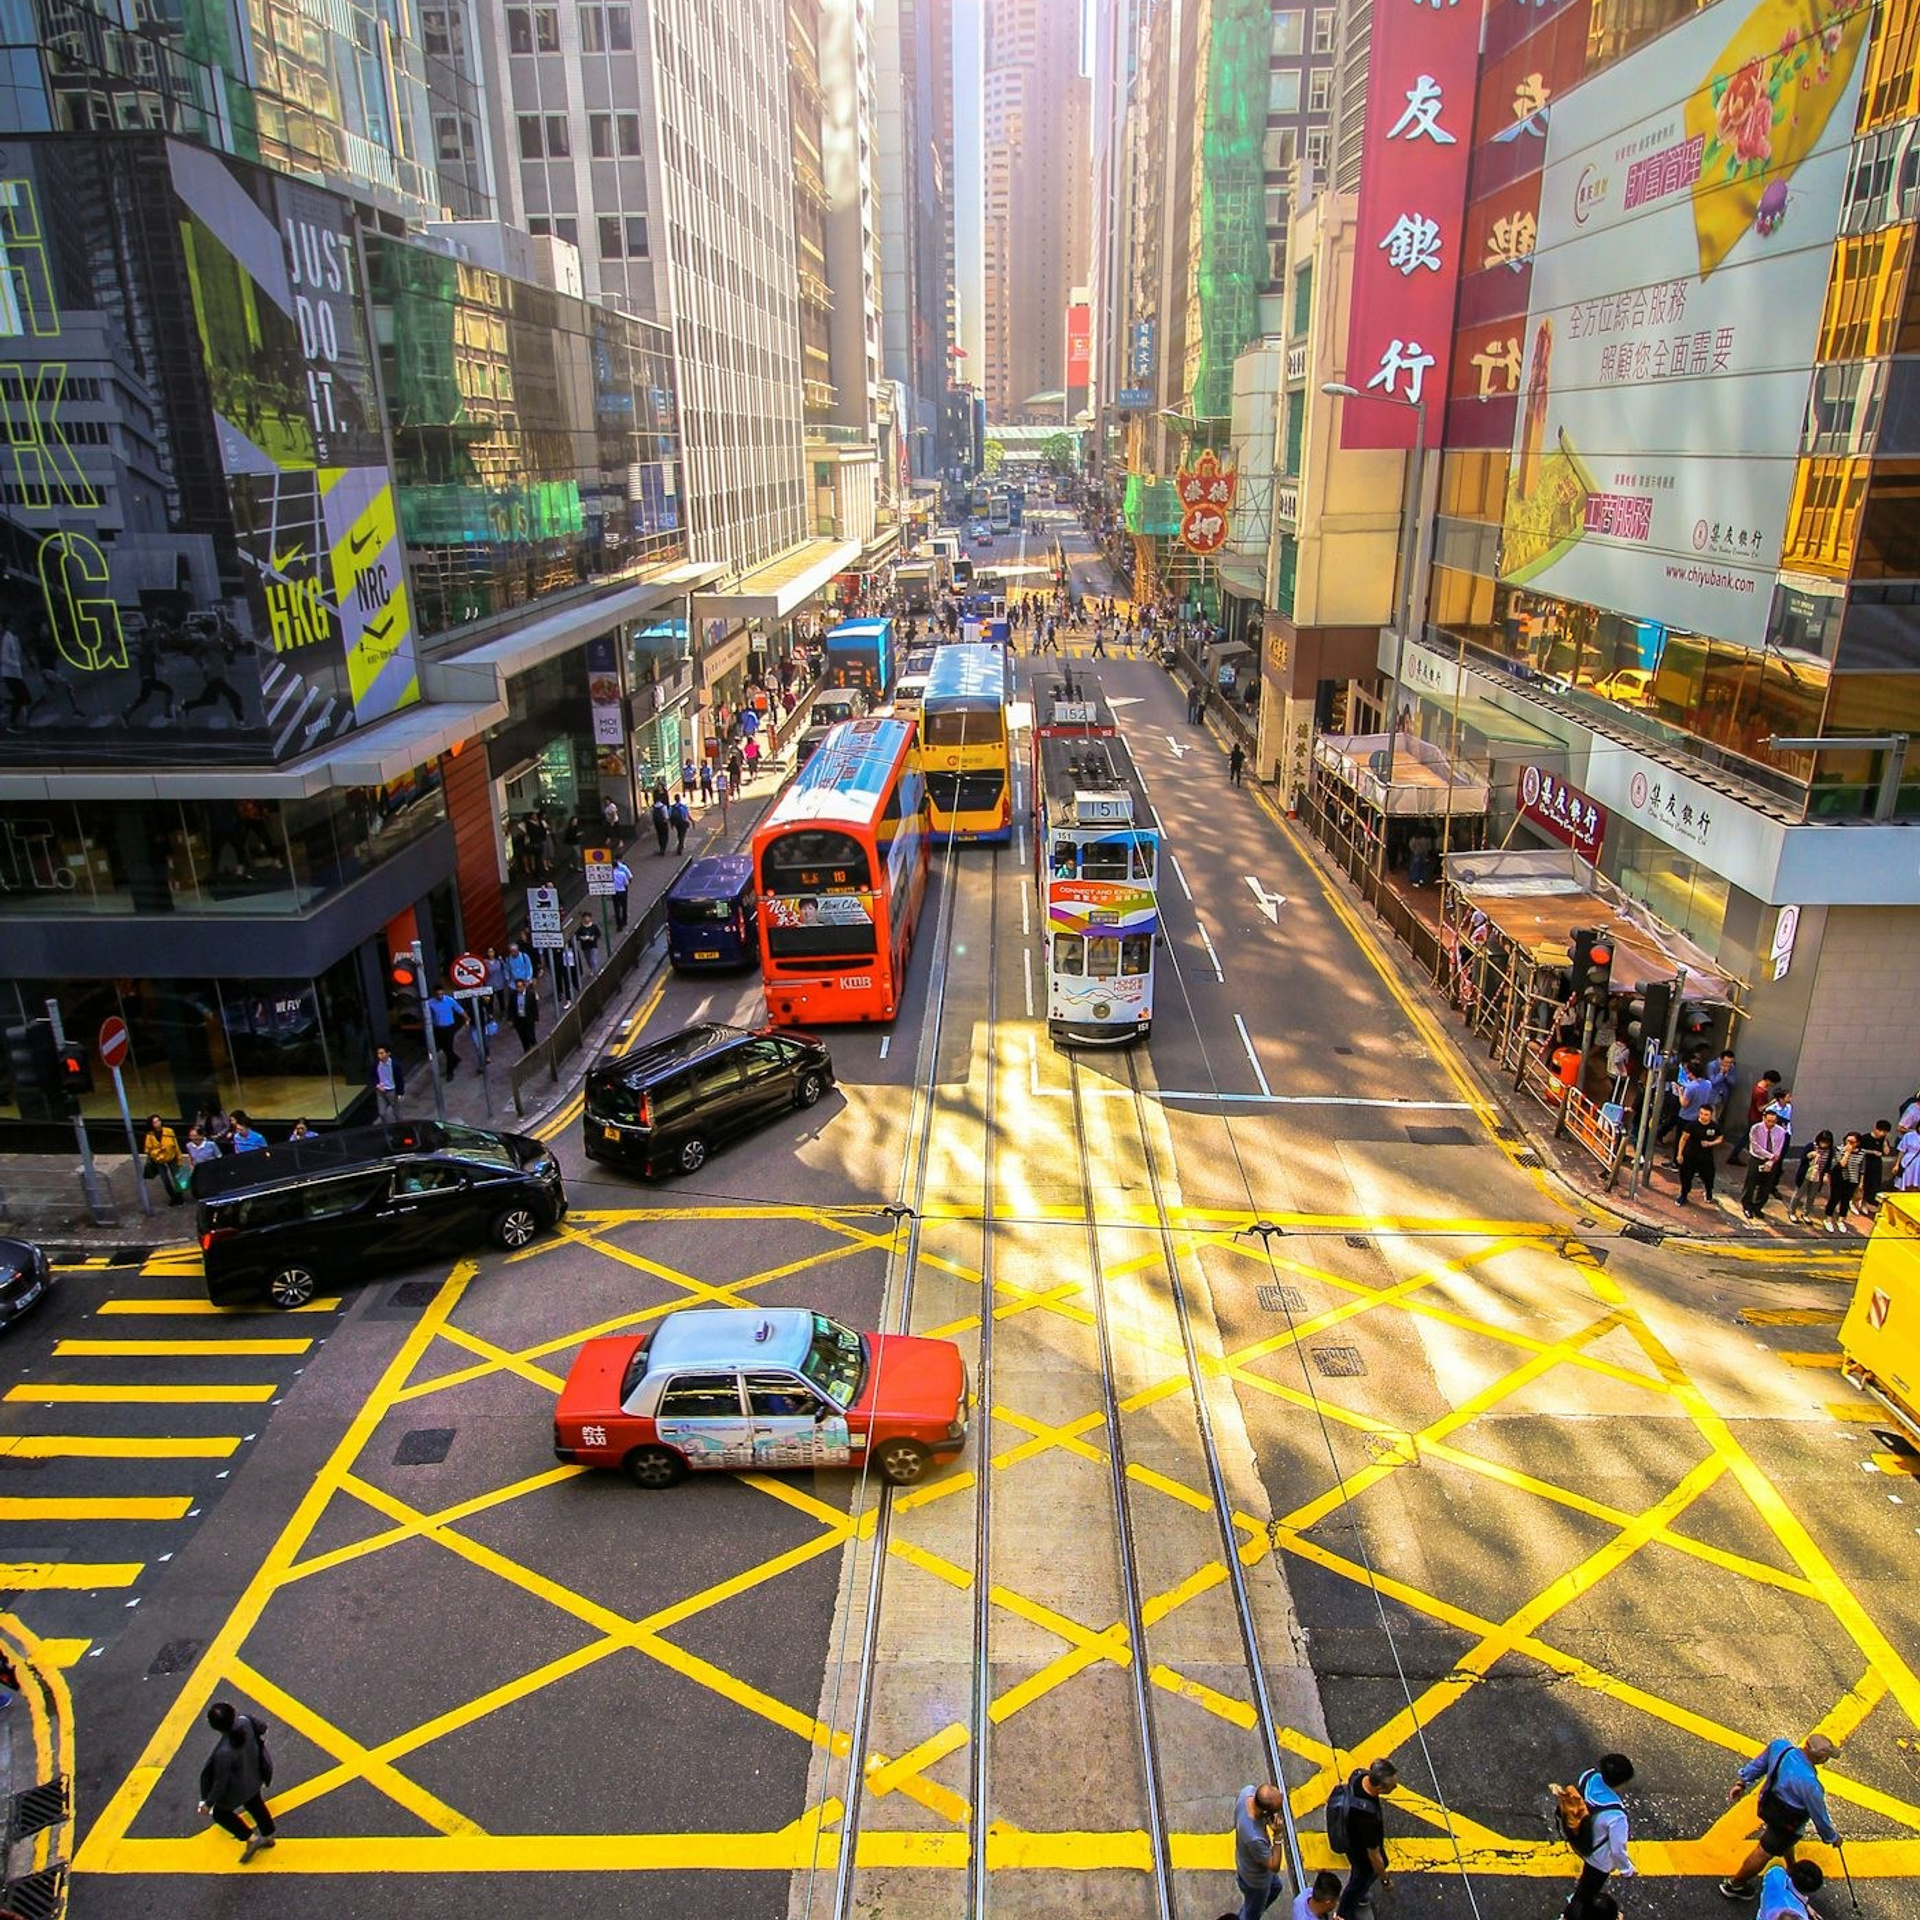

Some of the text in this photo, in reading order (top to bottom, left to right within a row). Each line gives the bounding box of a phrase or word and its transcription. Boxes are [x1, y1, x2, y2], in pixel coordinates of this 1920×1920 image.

[1625, 136, 1703, 209] 財富管理
[1366, 0, 1459, 404] 友銀行
[287, 218, 355, 293] JUST
[1568, 279, 1688, 340] 全方位綜合服務
[296, 295, 338, 362] DO
[1599, 327, 1735, 381] 照顧您全面需要
[307, 370, 347, 433] IT.
[1585, 495, 1652, 540] 工商服務
[1710, 523, 1763, 549] 集友銀行
[354, 563, 391, 612] NRC
[1665, 565, 1755, 593] www.chiyubank.com
[266, 575, 330, 653] HKG
[600, 718, 617, 726] MOI
[601, 726, 618, 735] MOI
[1065, 709, 1086, 720] 152
[1091, 802, 1119, 816] 151
[1541, 776, 1598, 836] 集友銀行
[1650, 783, 1711, 836] 集友銀行
[1058, 832, 1071, 840] 151
[1059, 887, 1095, 896] CONNECT
[839, 976, 872, 990] KMB
[1138, 1023, 1149, 1031] 151
[582, 1425, 606, 1436] 的士
[583, 1436, 607, 1446] TAXI
